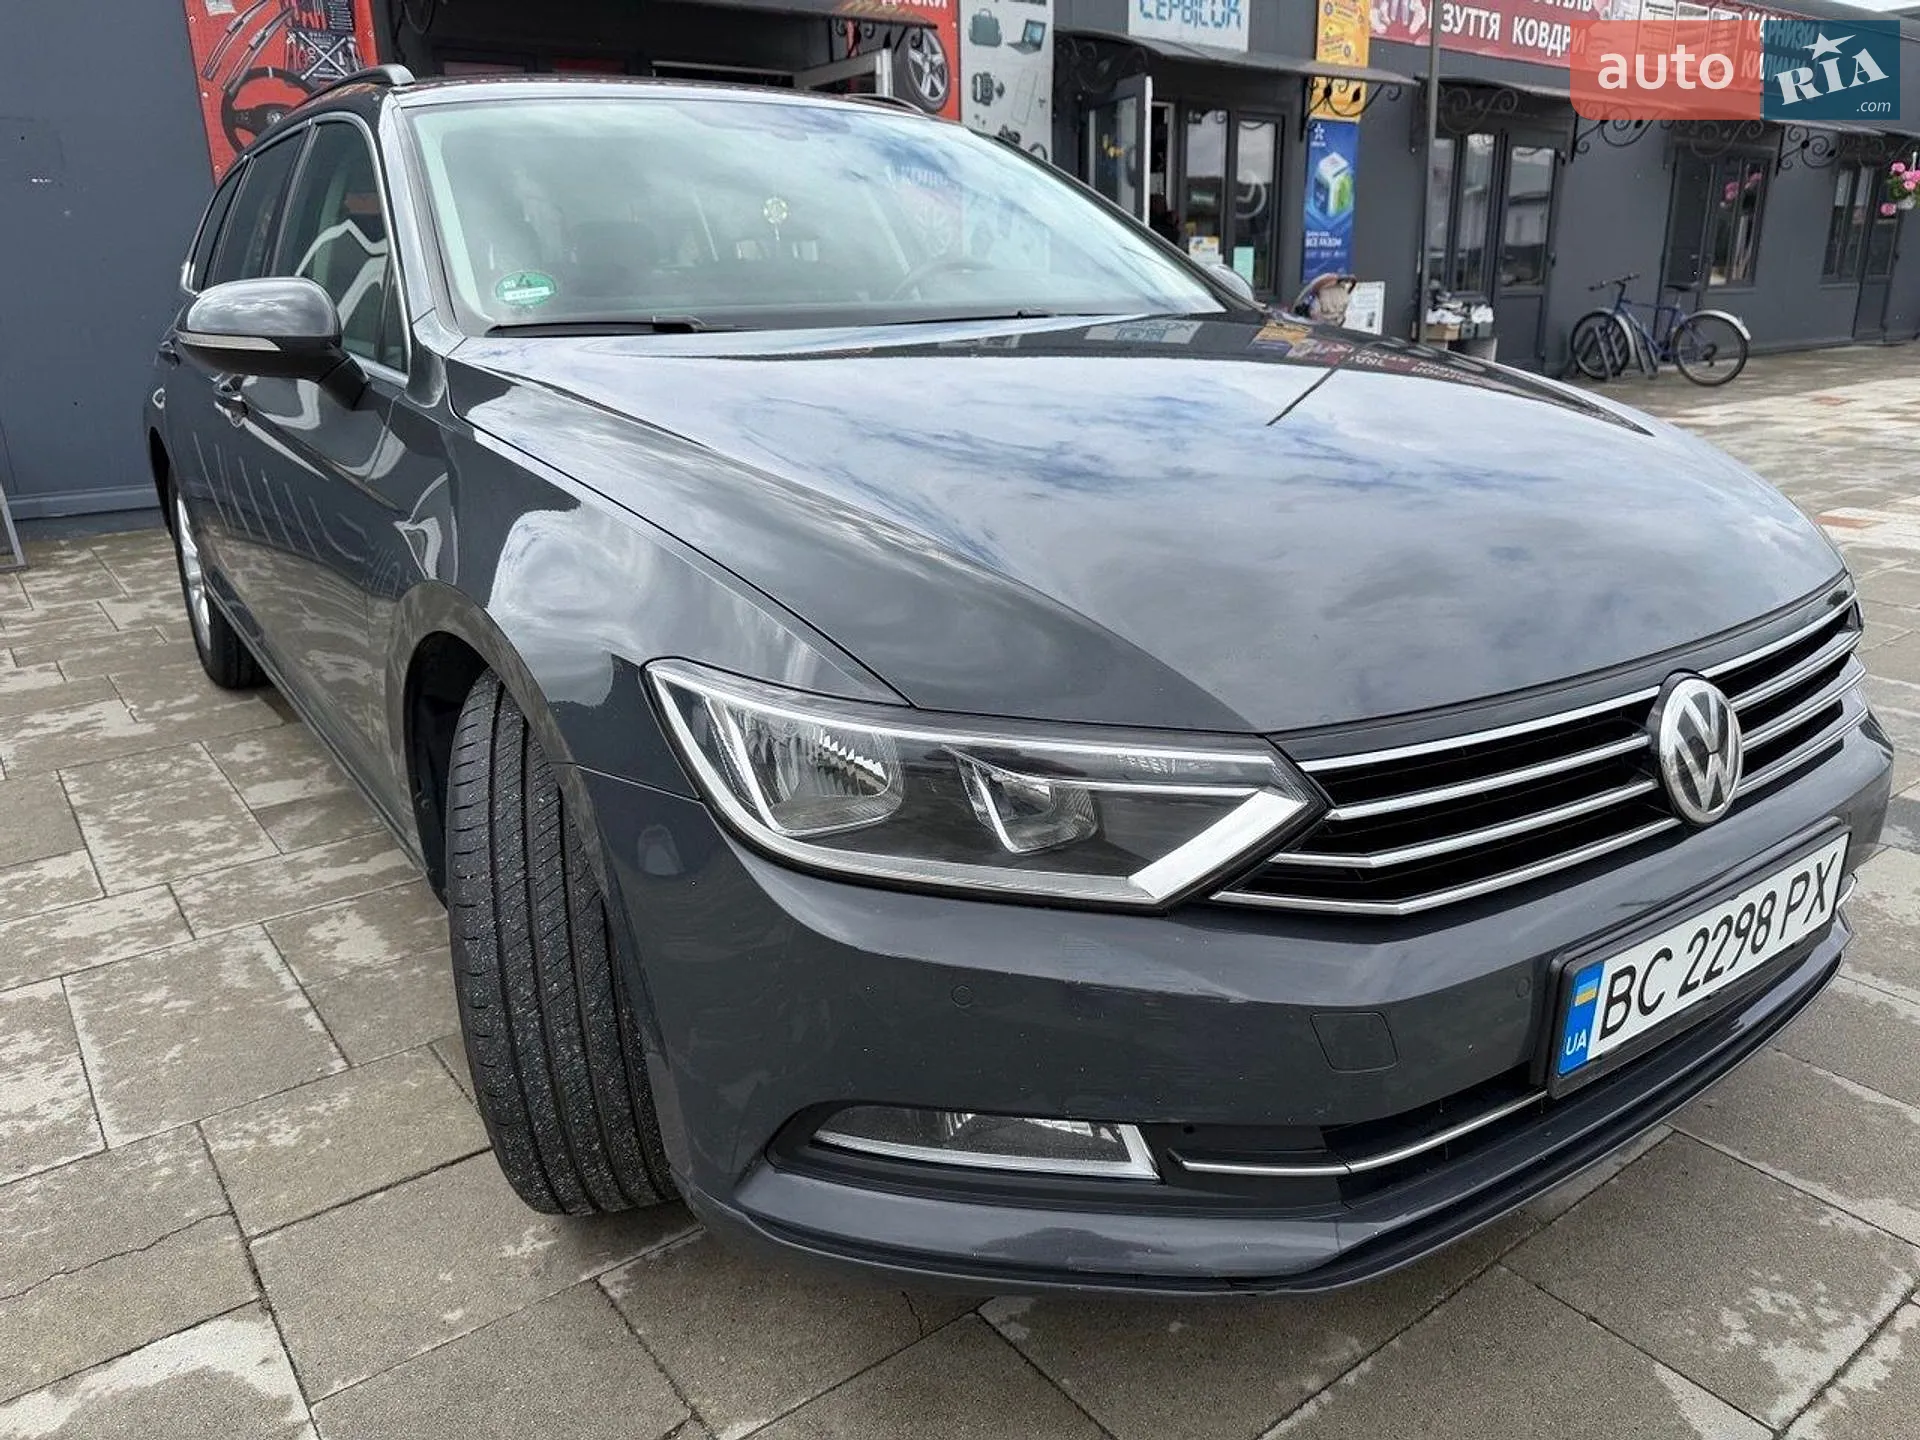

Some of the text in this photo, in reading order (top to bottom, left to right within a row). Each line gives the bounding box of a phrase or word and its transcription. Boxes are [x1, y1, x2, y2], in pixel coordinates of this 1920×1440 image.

[1440, 2, 1587, 57] ЗУТТЯ КОВДРИ
[1598, 850, 1839, 1042] BC 2298 PX
[1565, 1028, 1587, 1056] UA
